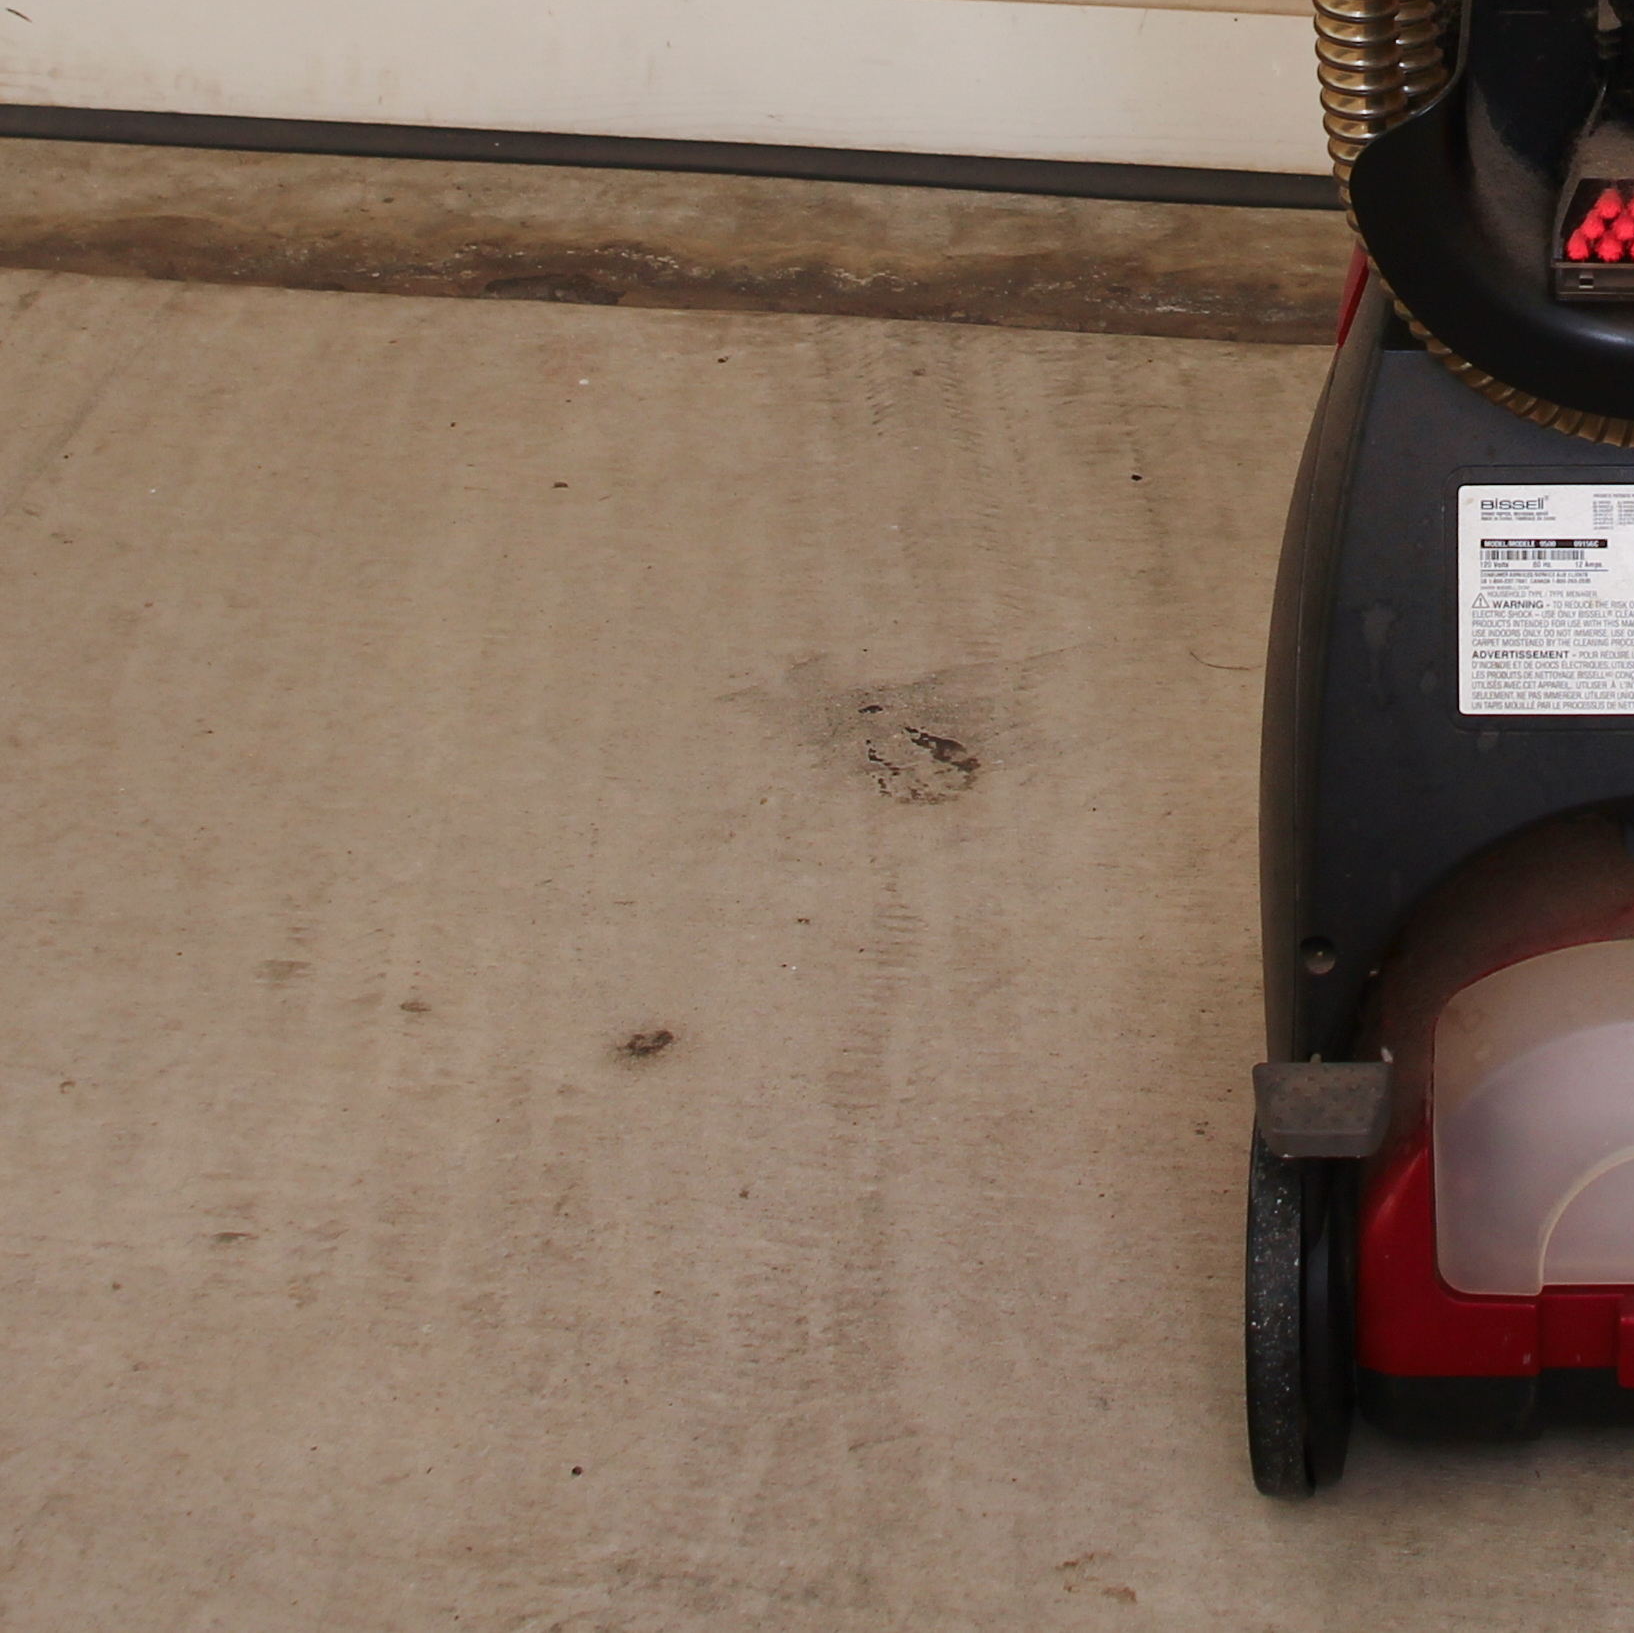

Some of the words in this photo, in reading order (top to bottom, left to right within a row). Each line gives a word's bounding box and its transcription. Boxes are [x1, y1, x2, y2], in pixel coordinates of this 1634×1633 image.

[1494, 561, 1509, 569] Volts
[1528, 590, 1544, 598] TYPE
[1549, 590, 1564, 598] TYPE
[1493, 600, 1544, 609] WARNING
[1553, 600, 1562, 609] TO
[1594, 600, 1609, 609] THE
[1611, 600, 1627, 609] RISK
[1472, 610, 1506, 618] ELECTRIC
[1508, 610, 1533, 618] SHOCK
[1542, 610, 1556, 618] USE
[1558, 610, 1576, 618] ONLY
[1472, 620, 1511, 628] PRODUCTS
[1513, 620, 1549, 628] INTENDED
[1551, 620, 1566, 628] FOR
[1567, 620, 1581, 628] USE
[1583, 620, 1602, 628] WITH
[1603, 620, 1620, 628] THIS
[1472, 629, 1486, 638] USE
[1556, 629, 1571, 638] NOT
[1611, 629, 1625, 638] USE
[1472, 639, 1500, 647] CARPET
[1546, 639, 1556, 647] BY
[1557, 639, 1571, 647] THE
[1573, 639, 1609, 647] CLEANING
[1472, 650, 1569, 659] ADVERTISSEMENT
[1472, 671, 1485, 679] LES
